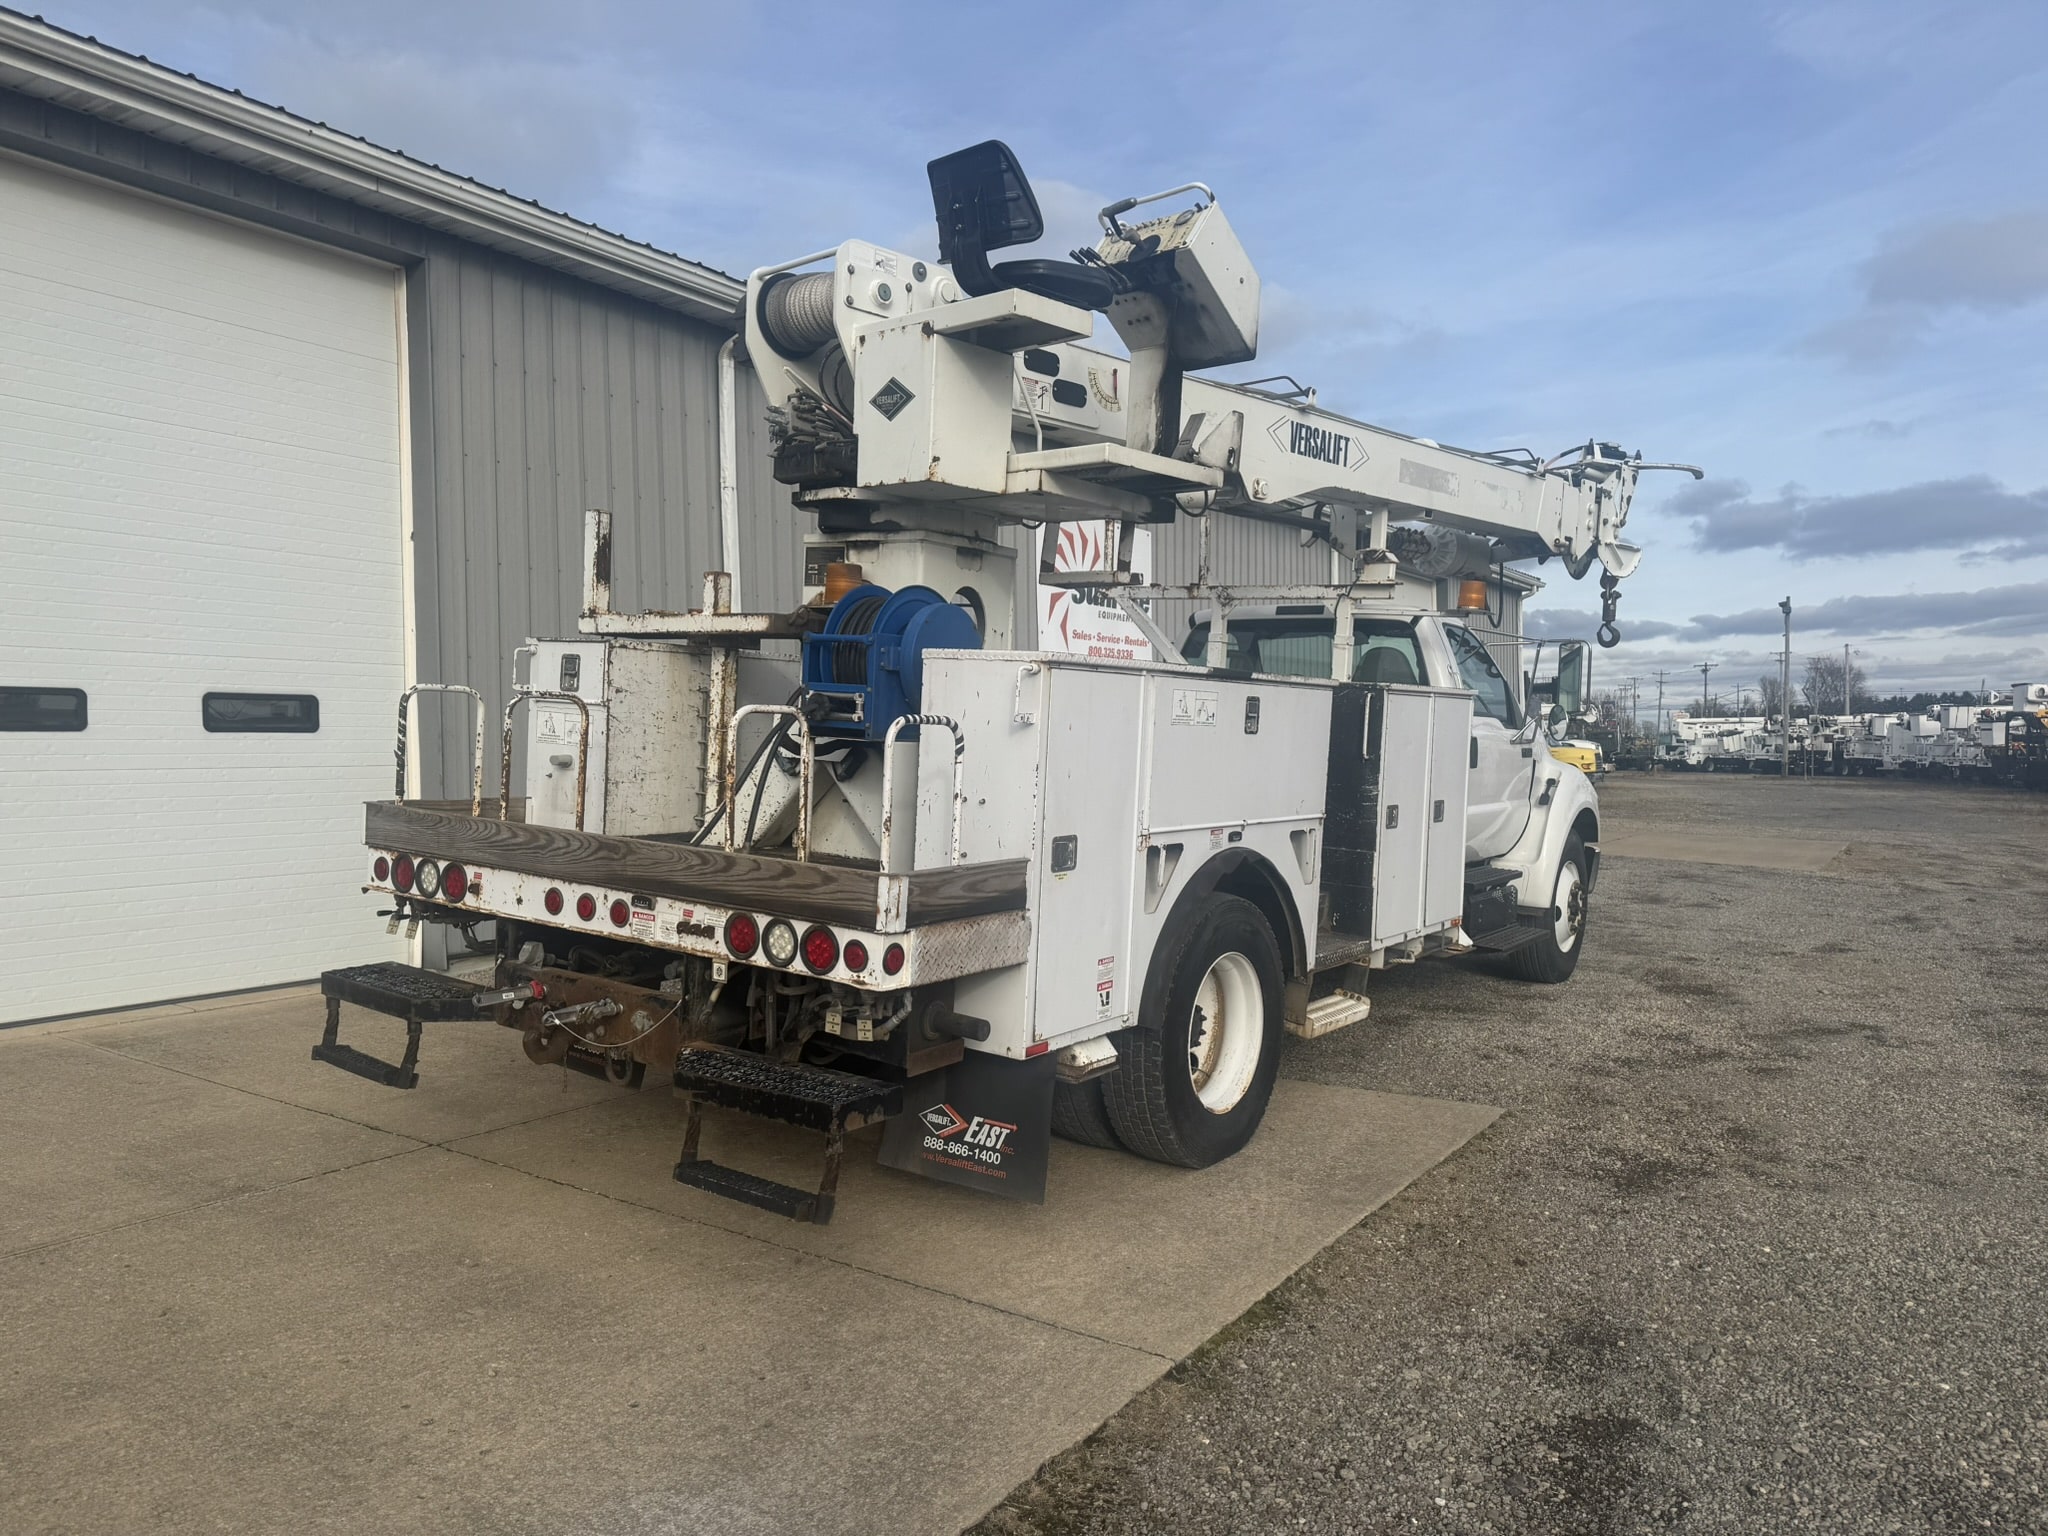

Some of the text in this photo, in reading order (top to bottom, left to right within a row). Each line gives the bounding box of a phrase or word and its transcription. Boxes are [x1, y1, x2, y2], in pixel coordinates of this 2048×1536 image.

[1290, 420, 1351, 467] VERSALIFT
[1072, 628, 1148, 648] Sales Service Rentals
[1088, 645, 1134, 660] 800.325.9336
[963, 1116, 1010, 1149] EAST
[923, 1136, 1001, 1164] 888-866-1400
